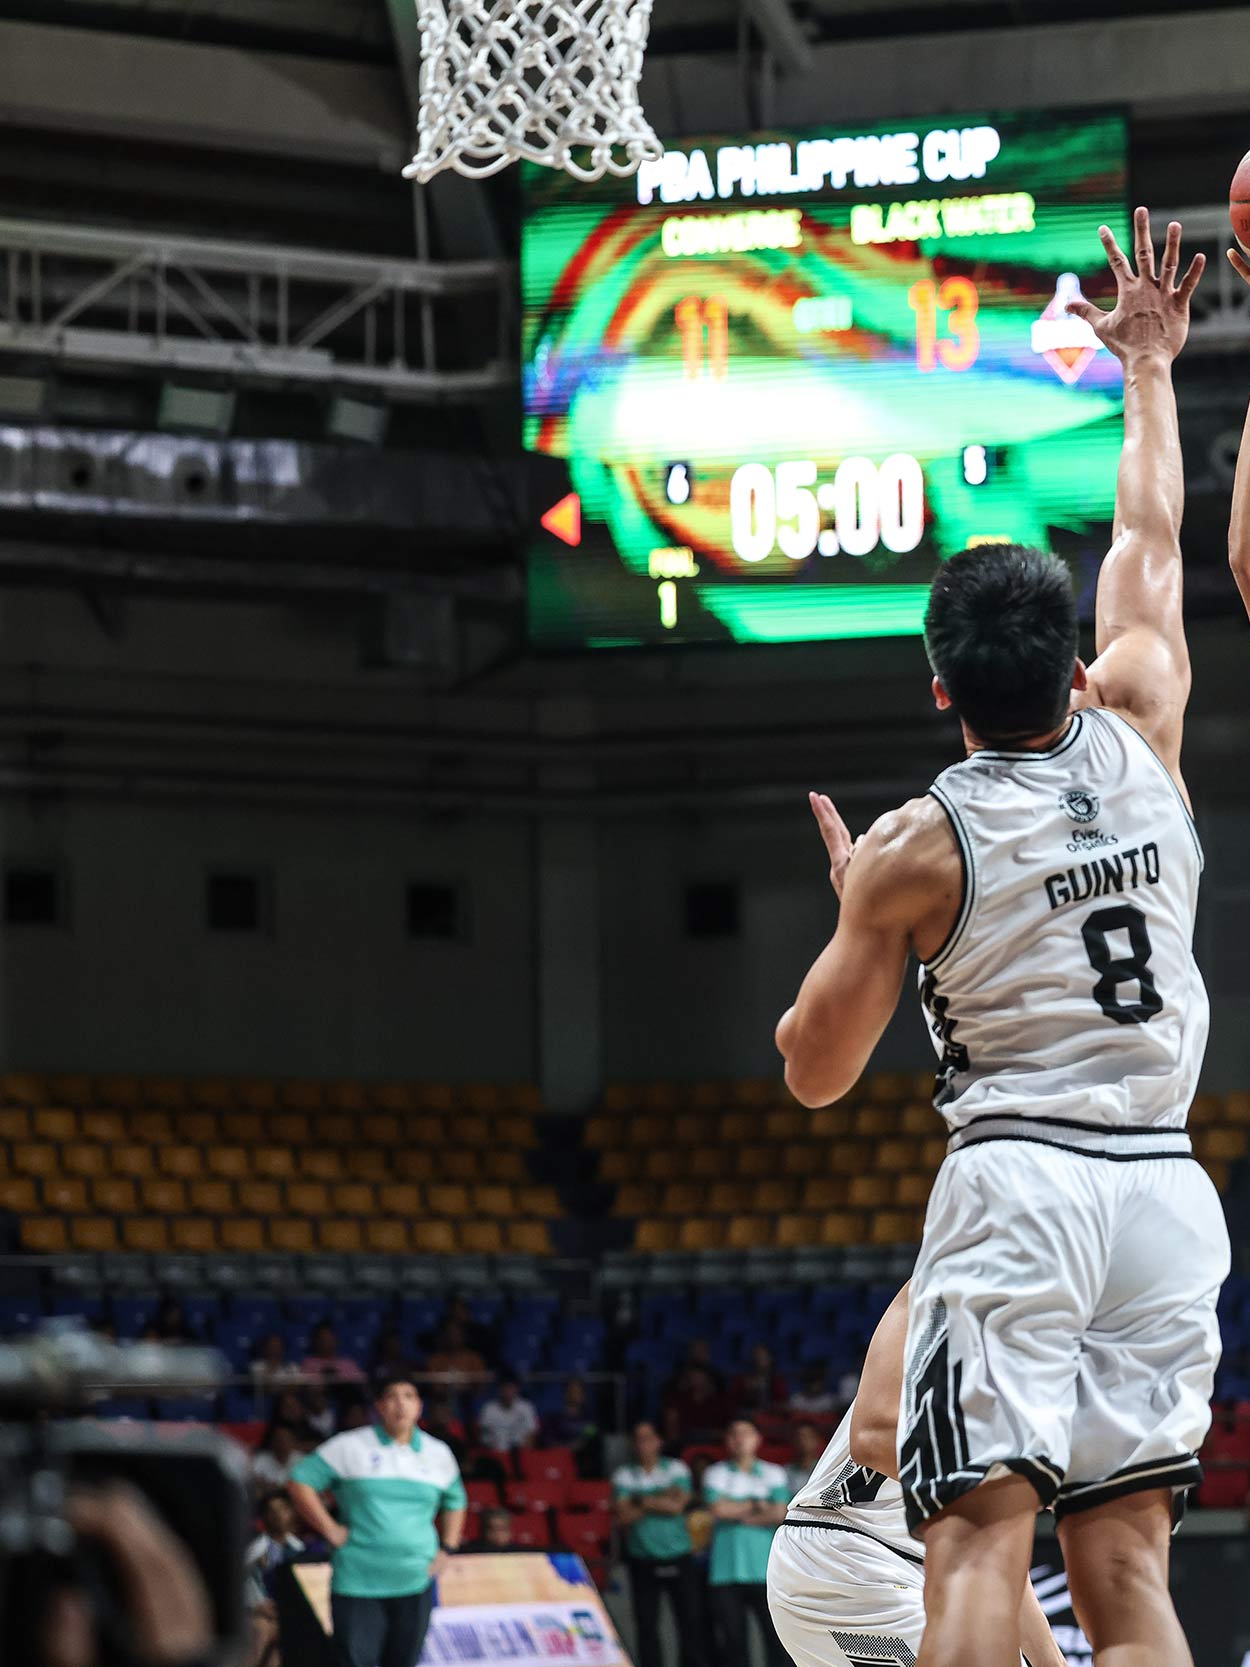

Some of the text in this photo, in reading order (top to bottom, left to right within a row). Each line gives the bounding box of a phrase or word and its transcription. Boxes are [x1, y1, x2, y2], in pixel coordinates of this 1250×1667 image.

[637, 126, 1000, 205] PBA PHILIPPINE CUP
[675, 294, 728, 382] 11
[909, 277, 979, 372] 13
[730, 453, 924, 562] 05:00
[1044, 842, 1159, 909] GUINTO
[1081, 904, 1163, 1024] 8
